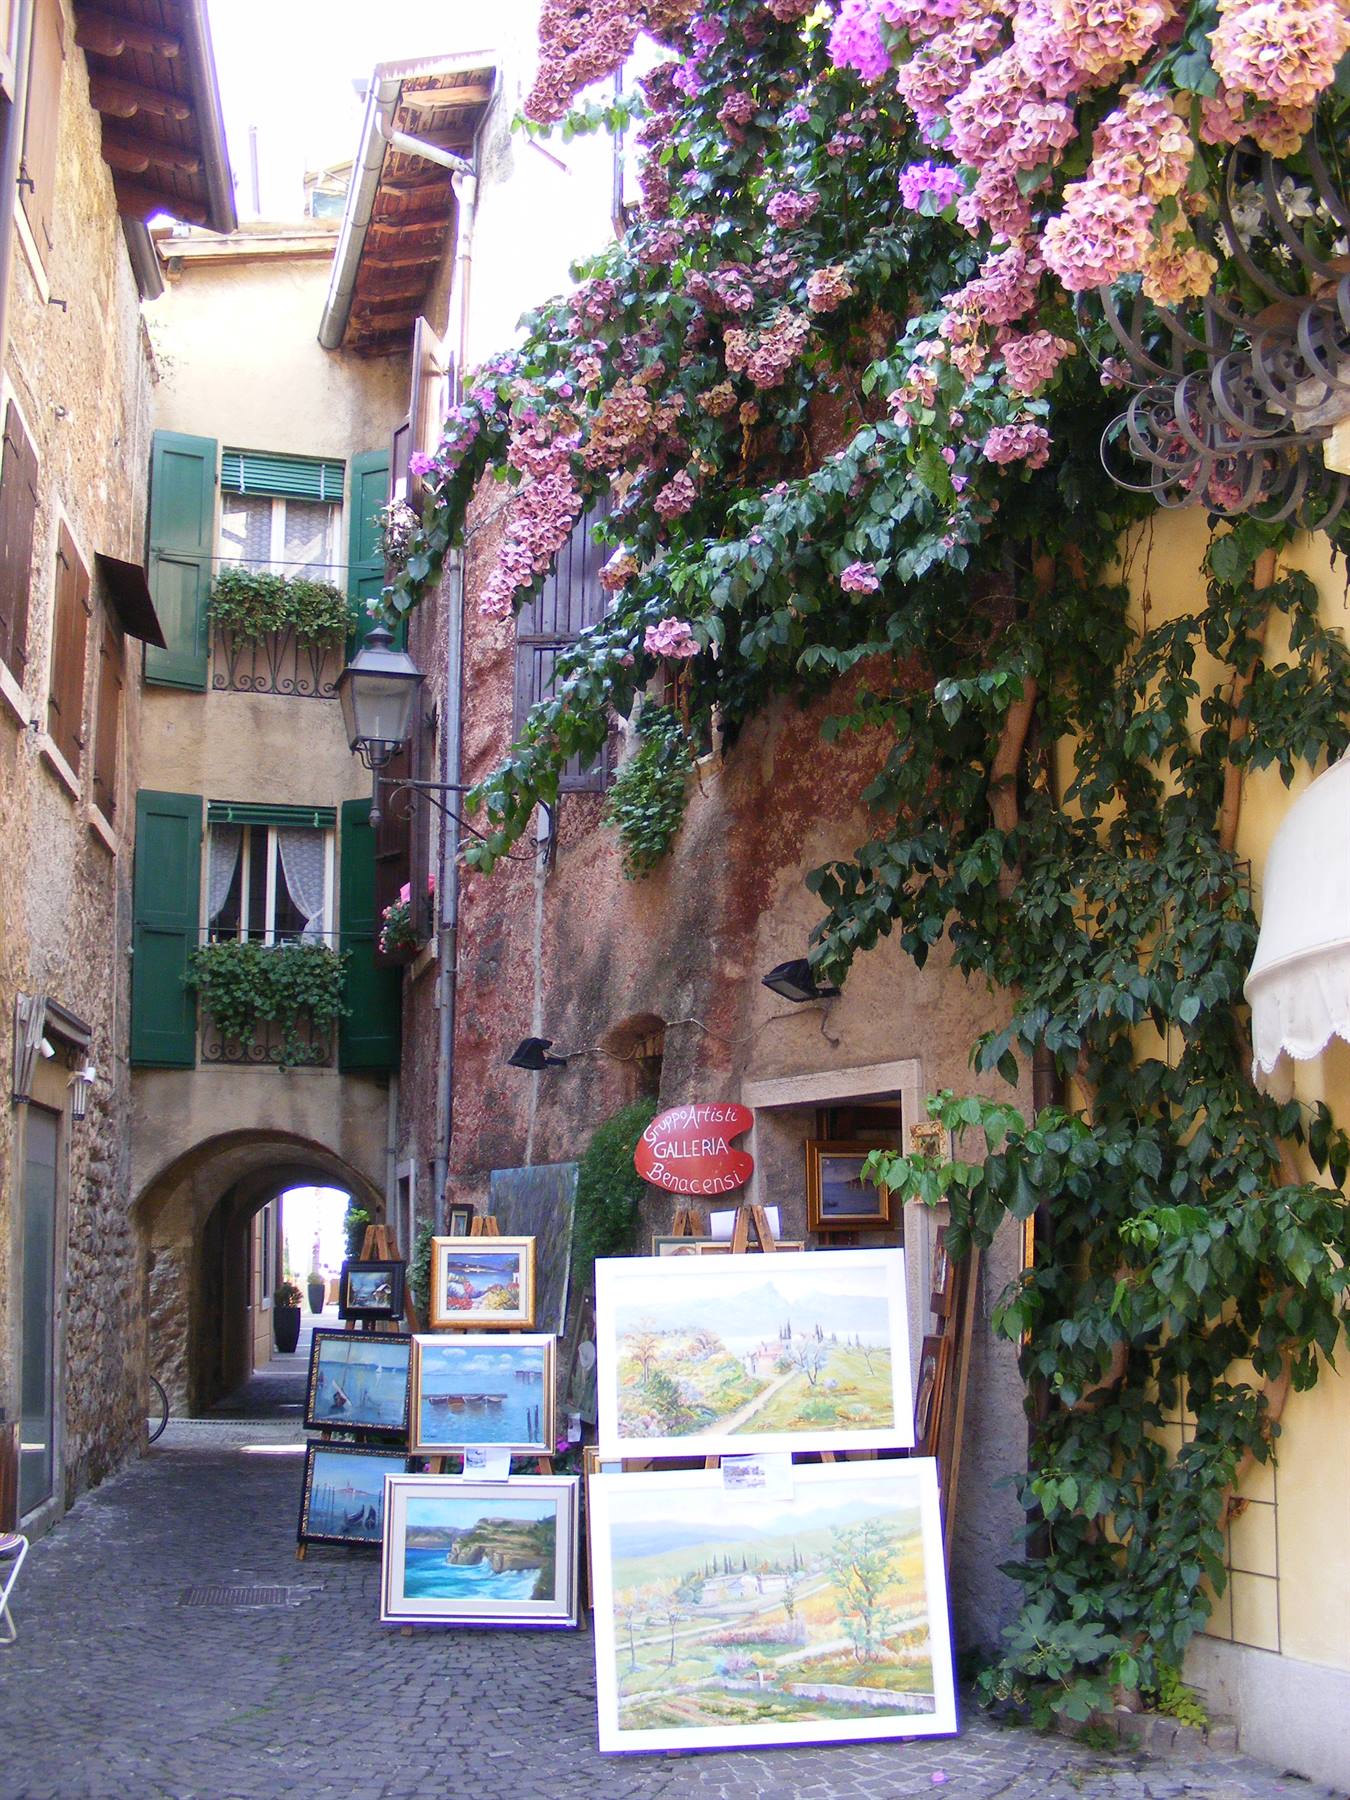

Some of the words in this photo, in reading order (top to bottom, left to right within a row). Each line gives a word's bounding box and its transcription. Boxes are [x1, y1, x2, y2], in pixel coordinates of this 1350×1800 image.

[643, 1110, 687, 1149] Gruppo
[683, 1105, 738, 1129] Artisti
[653, 1137, 729, 1159] GALLERIA
[646, 1162, 744, 1194] Benacensi
